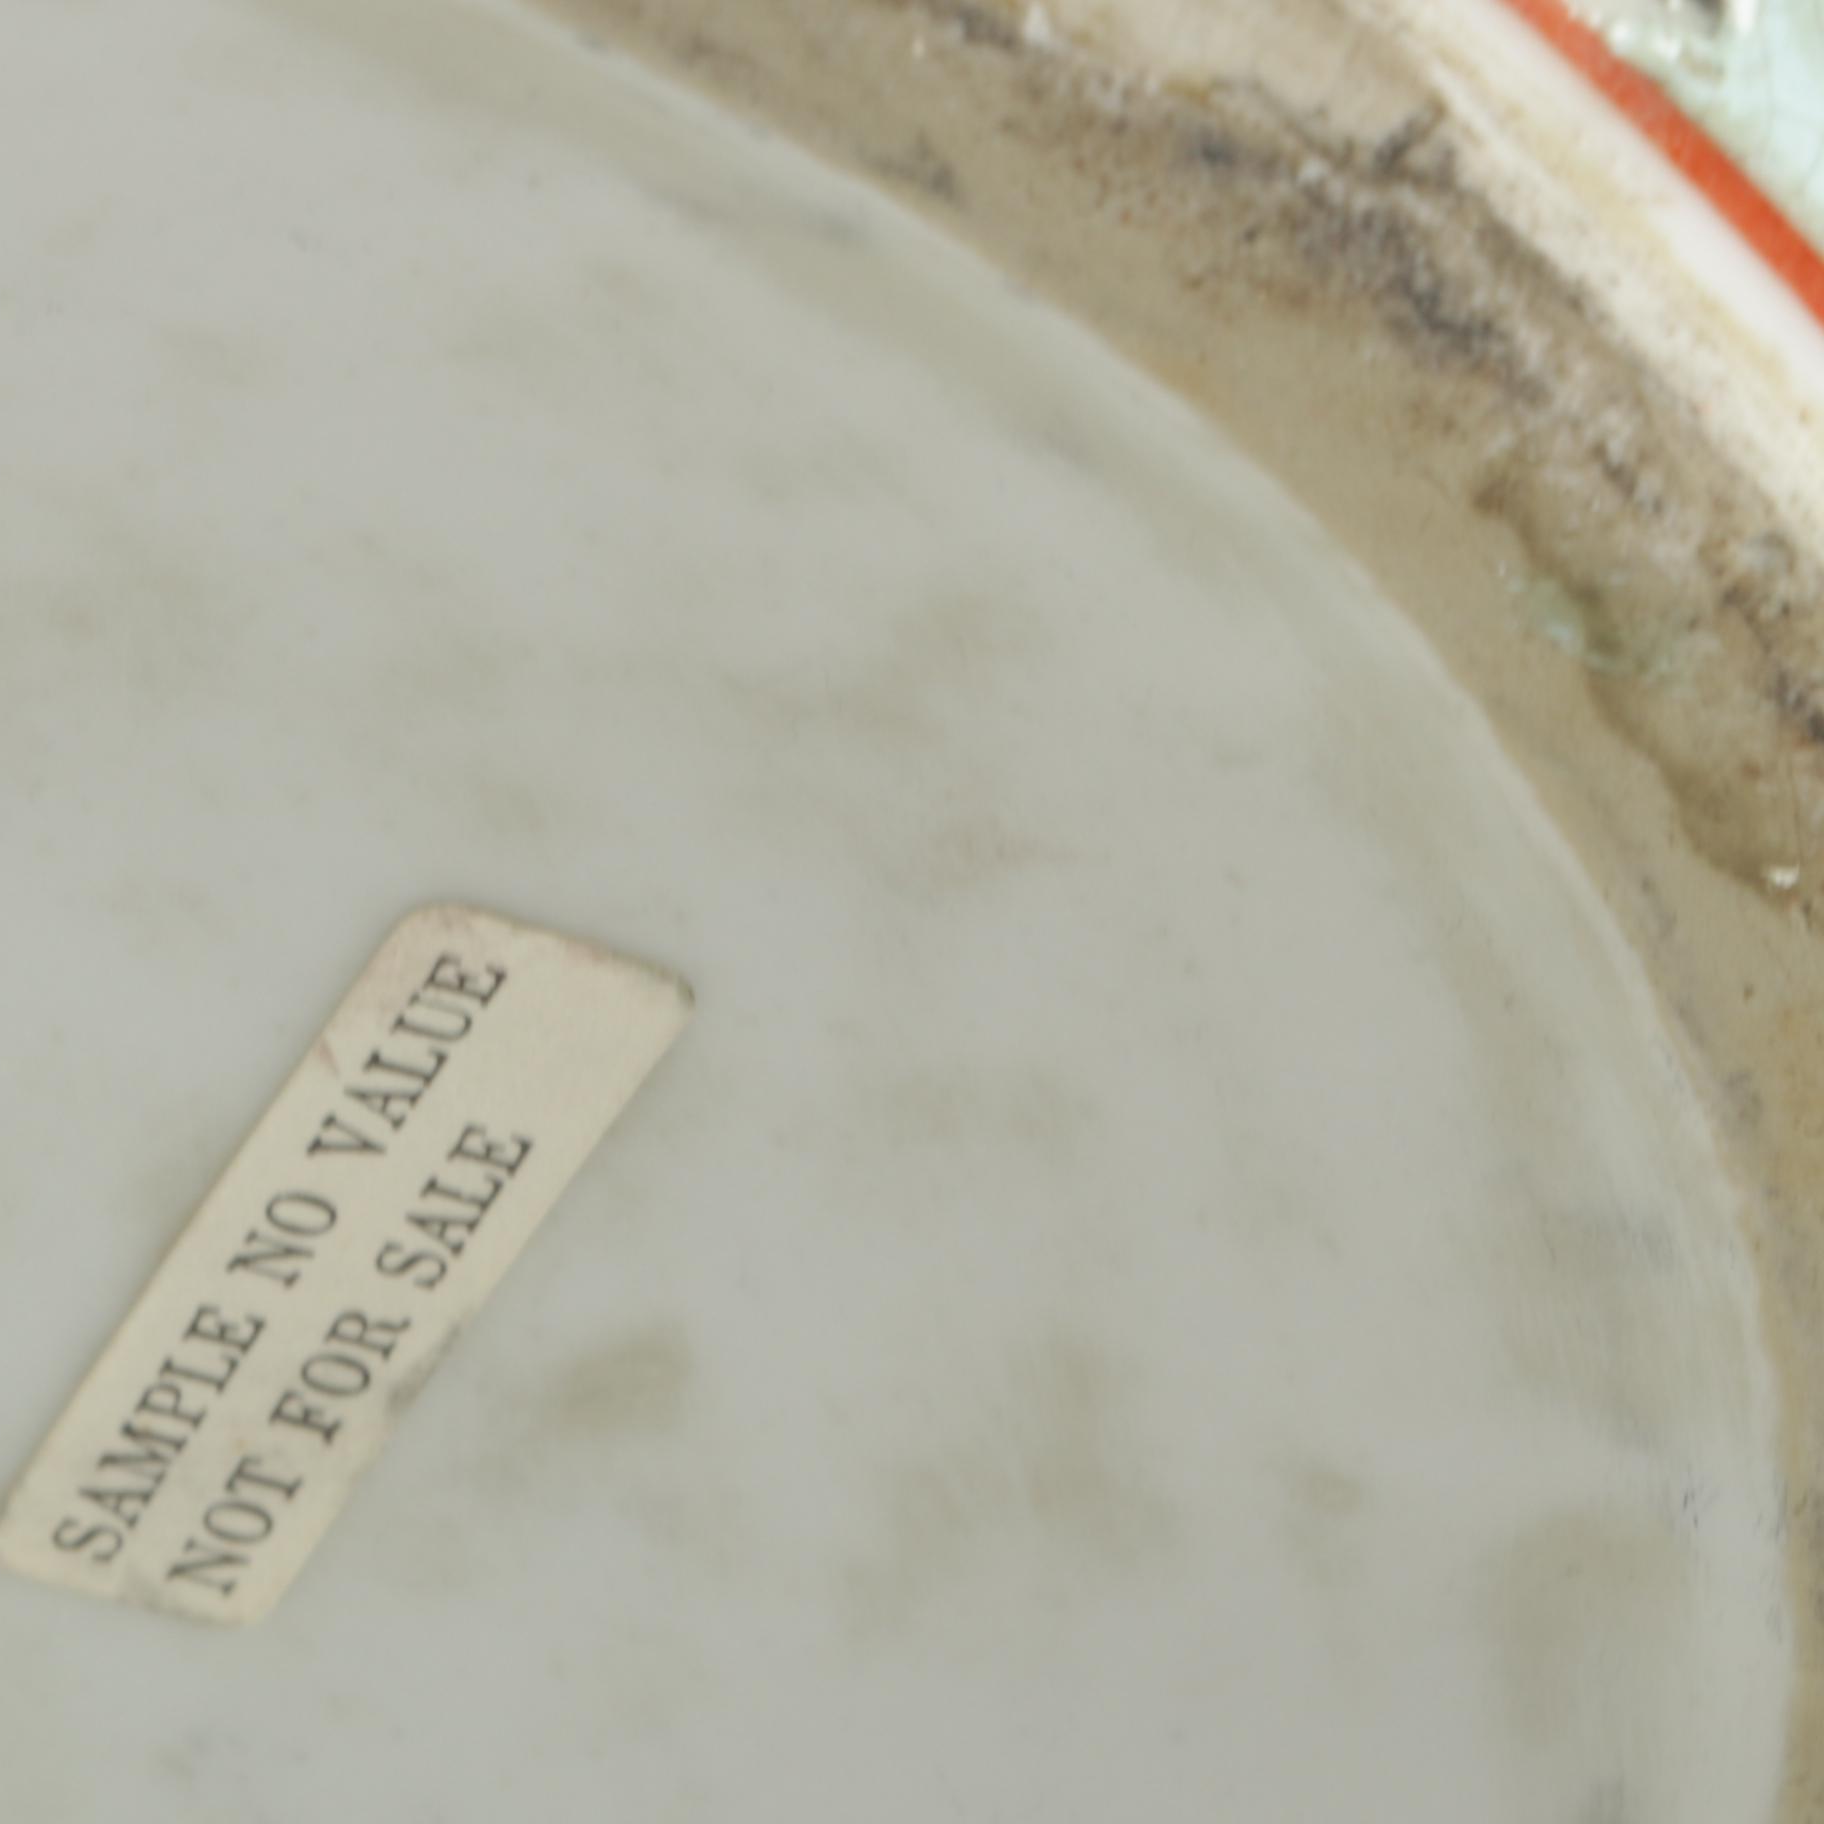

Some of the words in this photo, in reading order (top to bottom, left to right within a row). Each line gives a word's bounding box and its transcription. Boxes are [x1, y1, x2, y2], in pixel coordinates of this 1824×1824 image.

[52, 1304, 266, 1565] SAMPLE
[227, 1189, 339, 1290] NO
[306, 951, 508, 1162] VALUE
[165, 1455, 303, 1597] NOT
[269, 1308, 412, 1447] FOR
[374, 1121, 535, 1292] SALE
